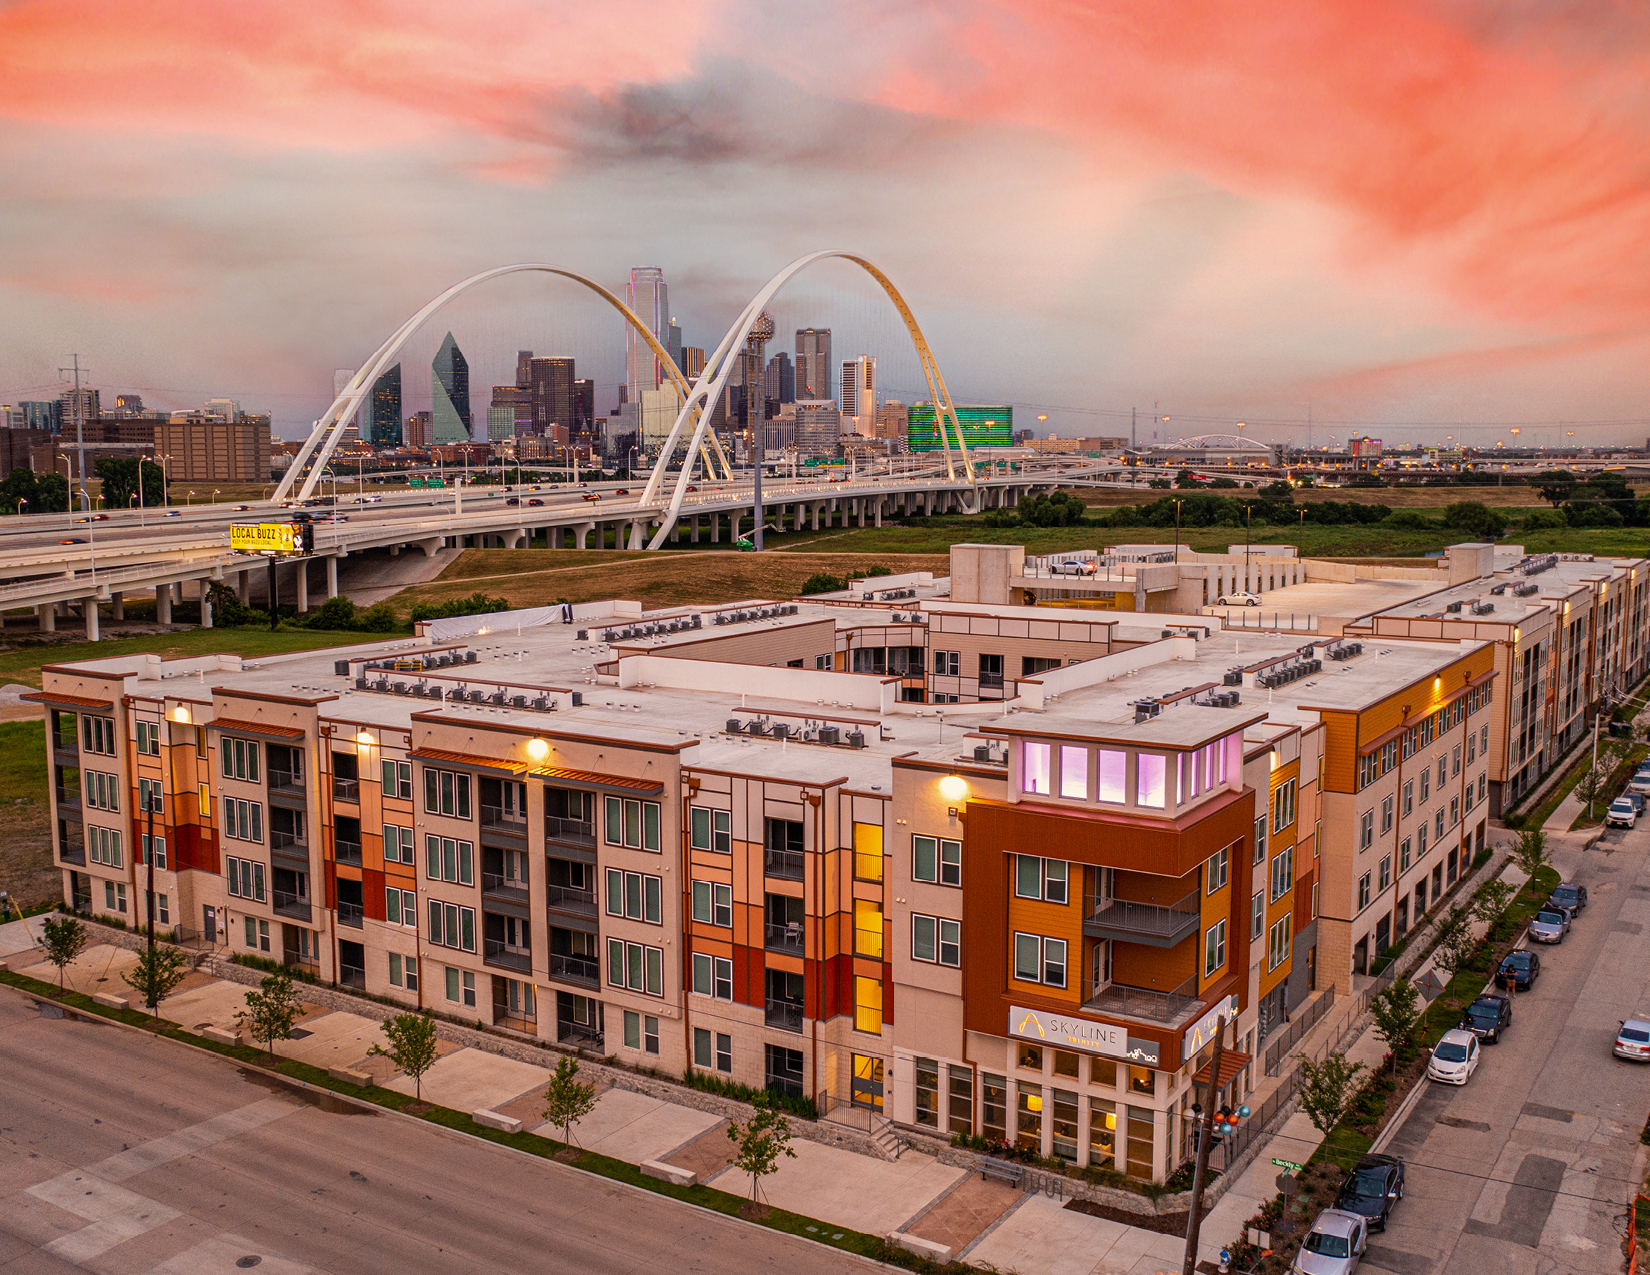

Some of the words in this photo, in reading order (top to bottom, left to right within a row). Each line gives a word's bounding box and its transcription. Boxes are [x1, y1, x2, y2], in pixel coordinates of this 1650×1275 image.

[232, 528, 255, 538] LOCAL
[257, 528, 275, 539] BUZZ
[1050, 1019, 1117, 1044] SKYLINE
[1067, 1036, 1100, 1048] TRINITY
